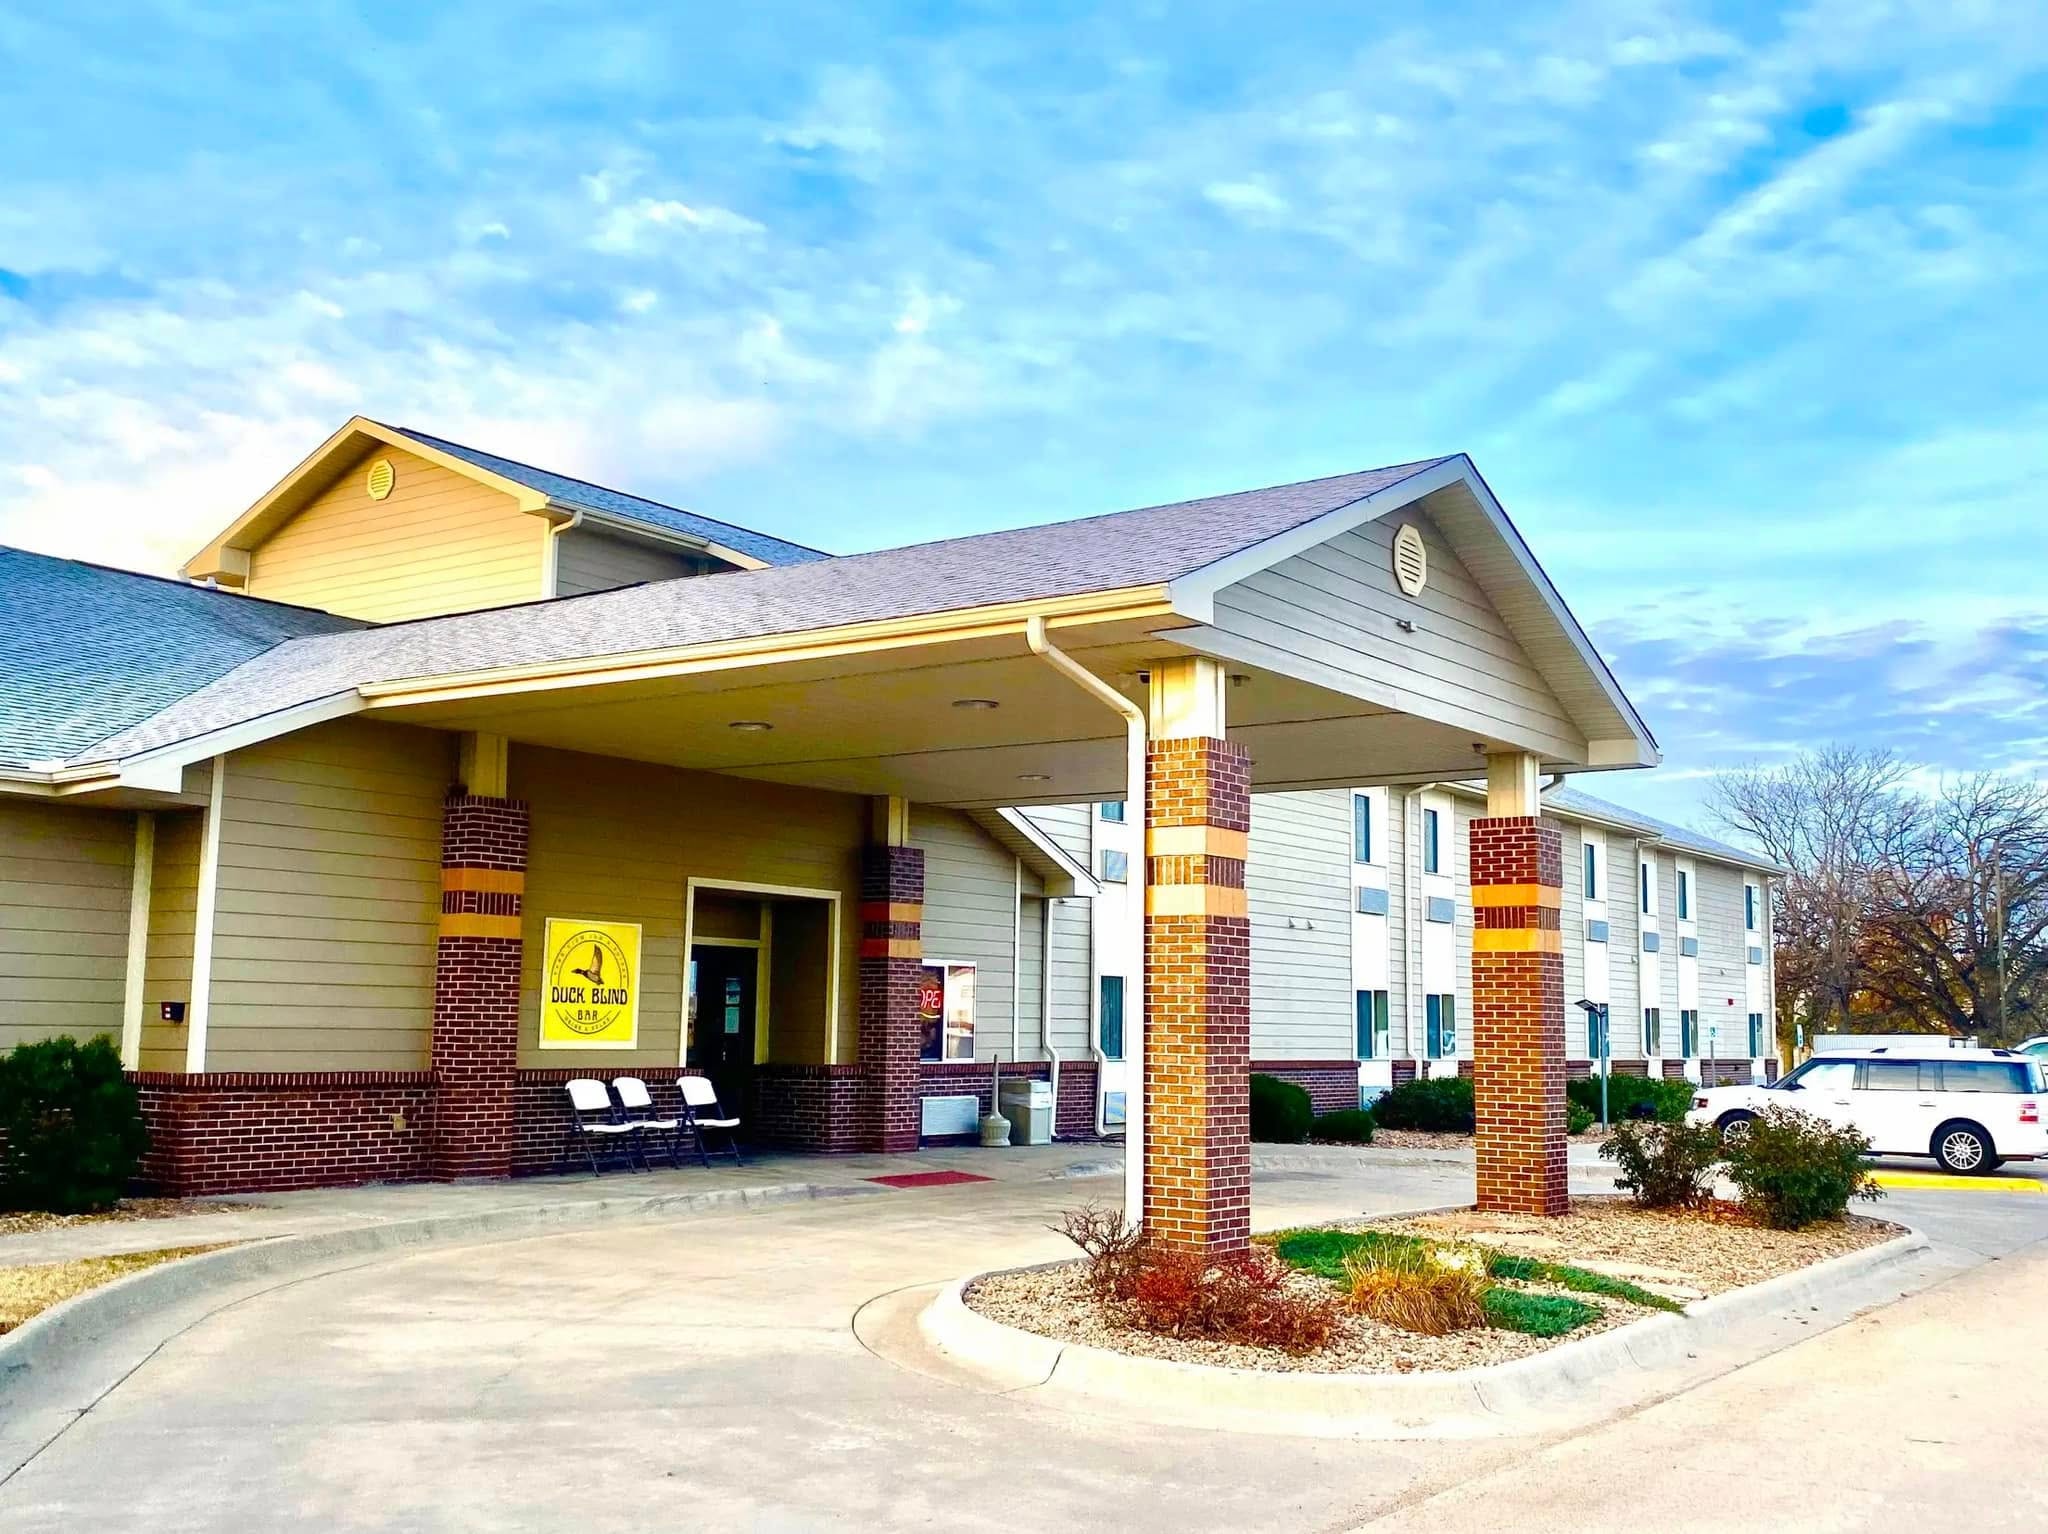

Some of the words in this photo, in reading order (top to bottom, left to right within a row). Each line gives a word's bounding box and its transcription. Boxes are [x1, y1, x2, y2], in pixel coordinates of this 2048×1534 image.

[551, 986, 586, 1004] DUCK
[592, 988, 628, 1005] BLIND
[920, 989, 941, 1009] OPE
[577, 1009, 598, 1020] BAR
